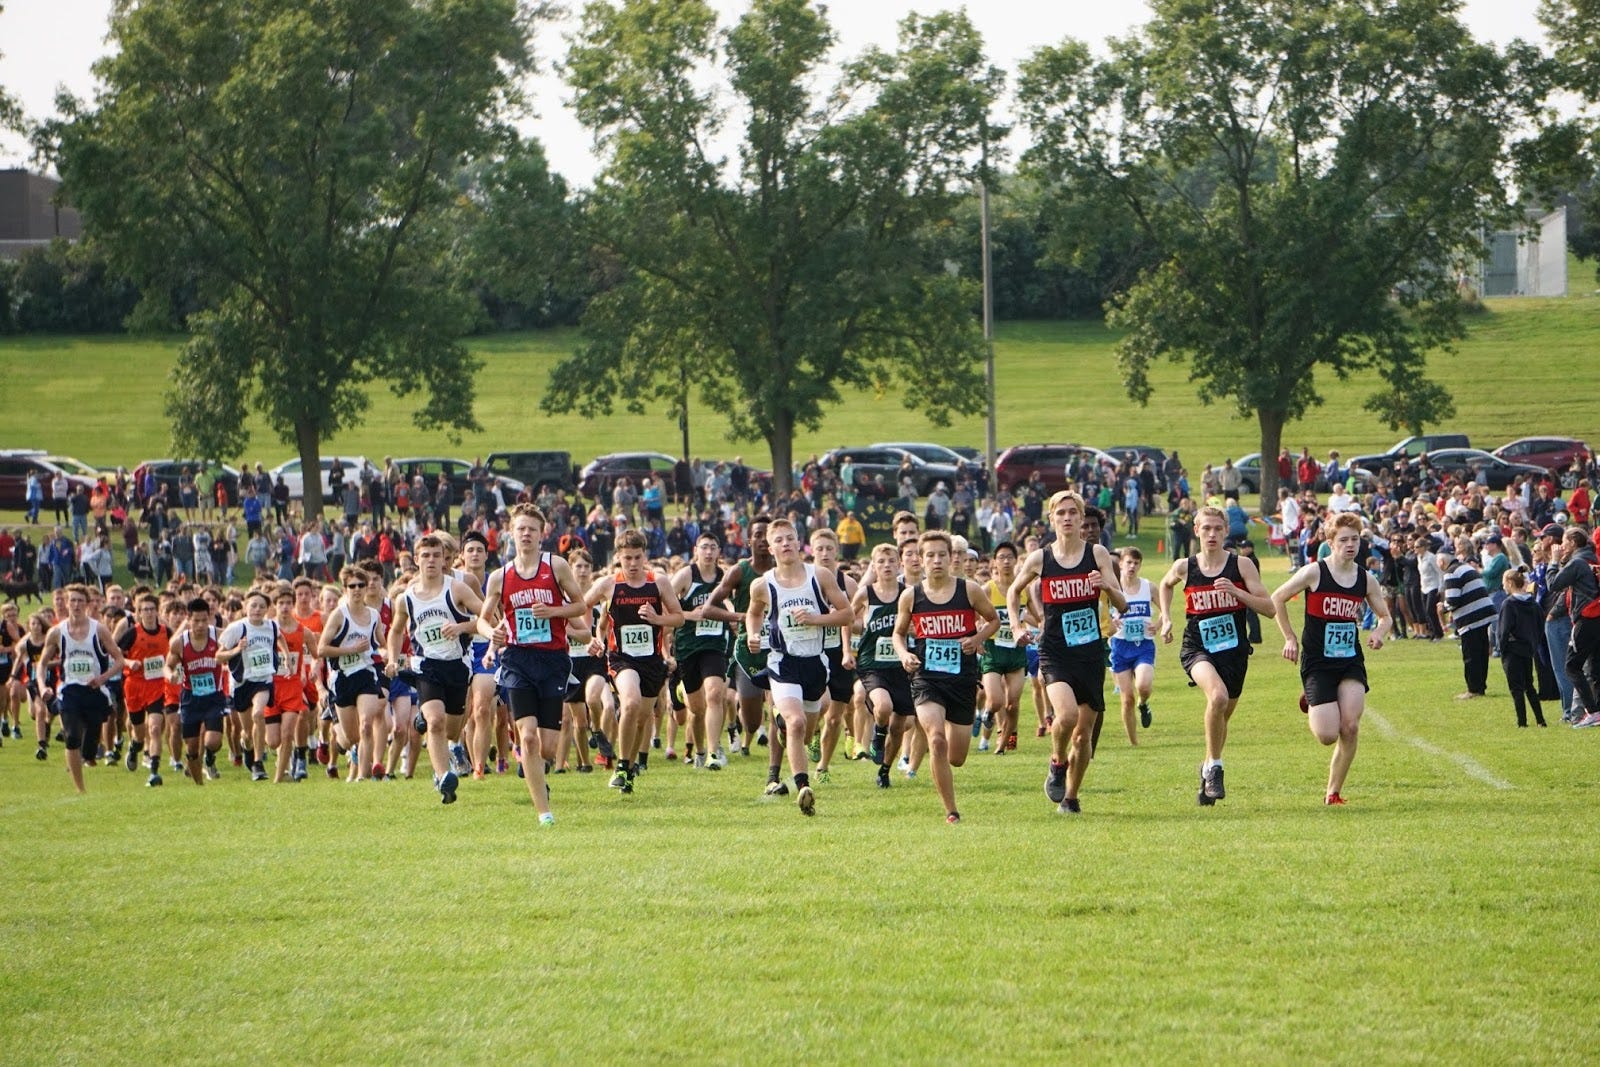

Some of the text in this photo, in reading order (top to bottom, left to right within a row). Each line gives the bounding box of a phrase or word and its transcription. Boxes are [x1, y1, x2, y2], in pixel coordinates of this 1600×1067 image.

[1049, 578, 1096, 600] CENTRAL
[416, 608, 450, 624] ZEPHYRS
[518, 616, 547, 631] 7617
[920, 613, 967, 636] CENTRAL
[1065, 615, 1093, 634] 7527
[1203, 622, 1234, 641] 7539
[425, 627, 443, 643] 137
[625, 631, 650, 645] 1249
[1328, 631, 1354, 645] 7542
[928, 646, 958, 661] 7545
